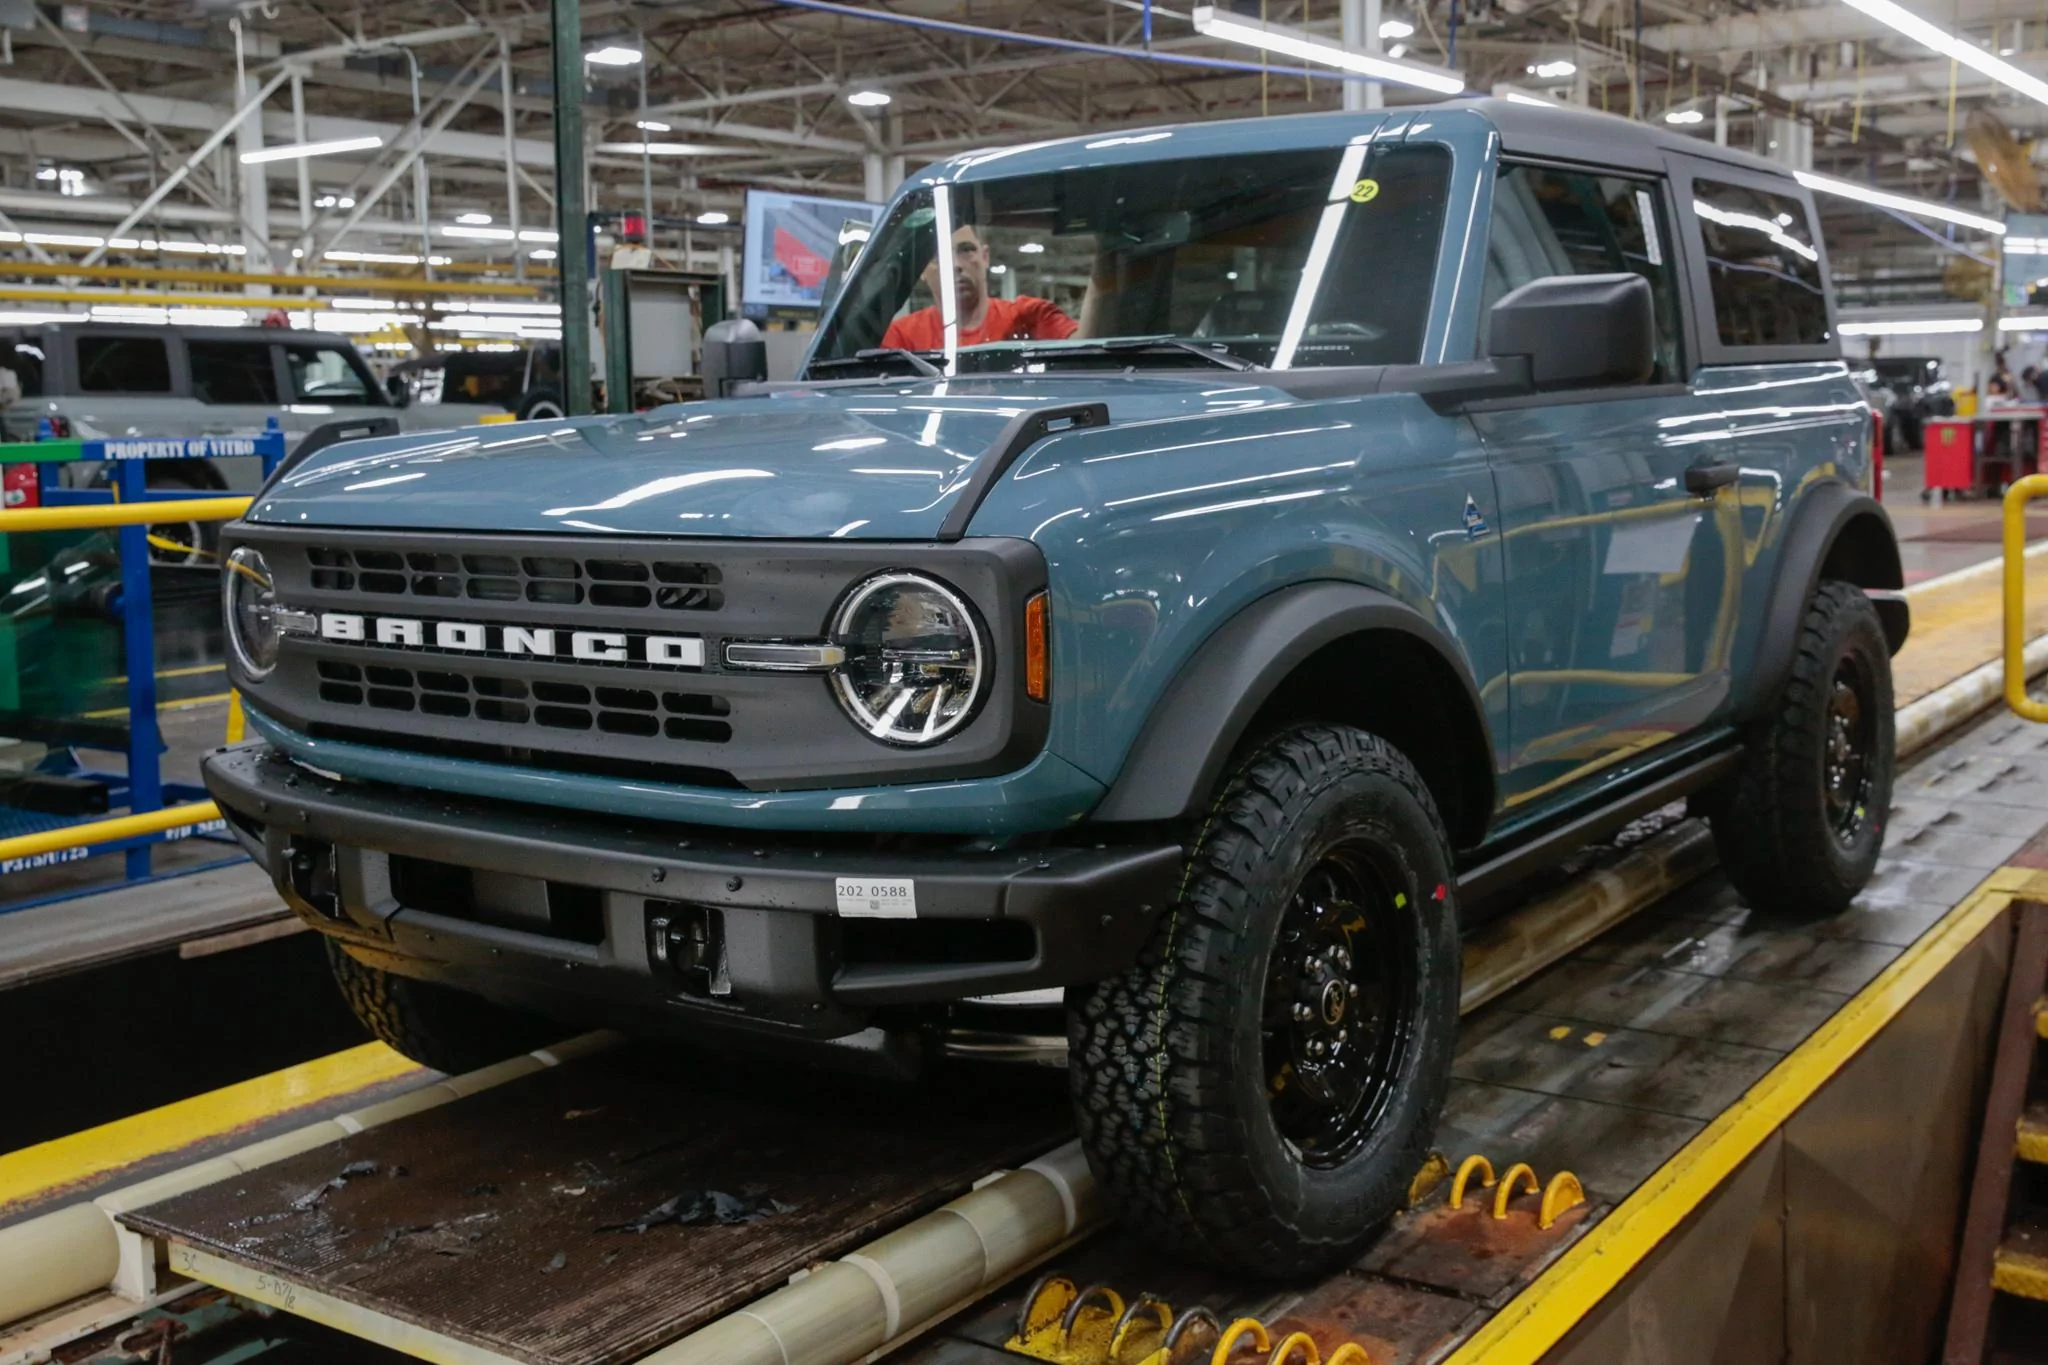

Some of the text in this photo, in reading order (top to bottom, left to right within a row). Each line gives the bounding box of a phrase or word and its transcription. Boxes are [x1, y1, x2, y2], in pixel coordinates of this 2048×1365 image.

[1353, 183, 1375, 198] 22
[104, 439, 255, 460] PROPERTY OF VITRO
[321, 612, 705, 667] BRONCO
[838, 885, 907, 897] 202 0588
